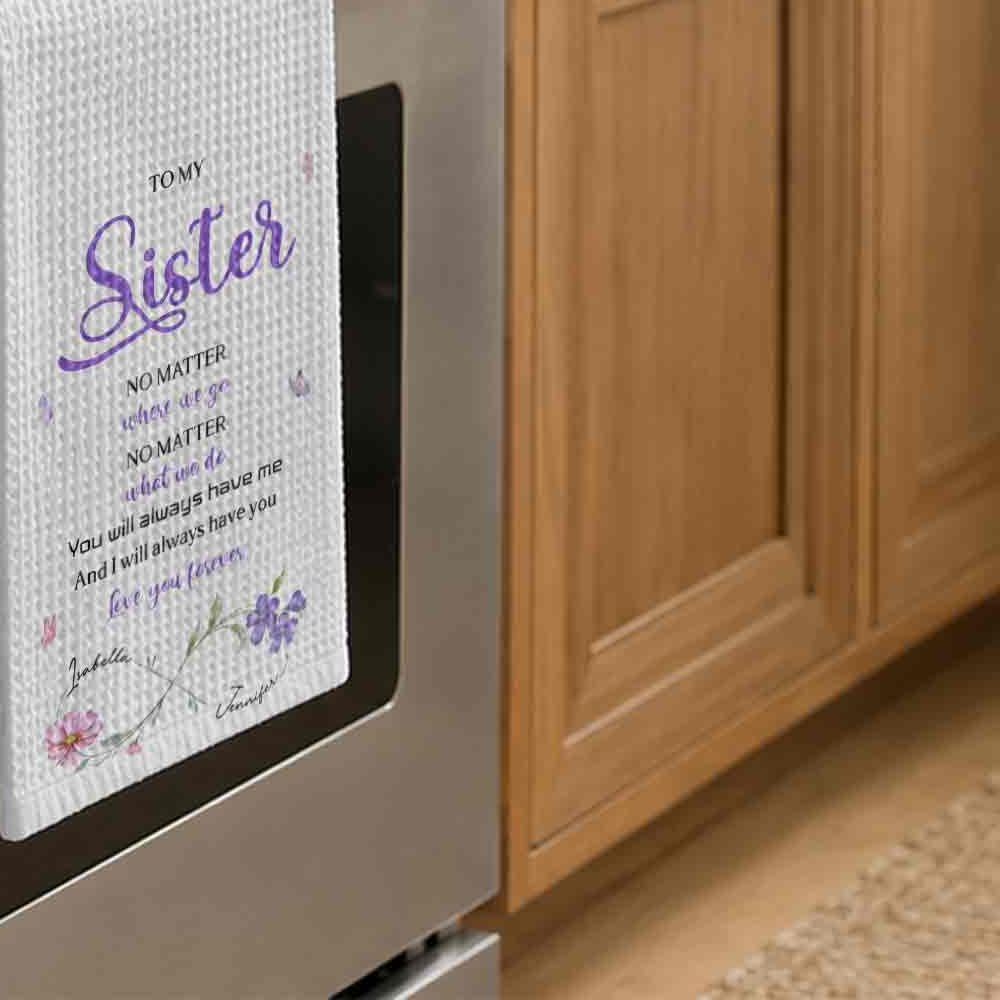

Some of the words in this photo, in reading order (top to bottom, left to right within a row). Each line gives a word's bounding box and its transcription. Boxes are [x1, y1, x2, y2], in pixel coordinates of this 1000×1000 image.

[149, 170, 175, 193] TO
[178, 159, 205, 183] MY
[57, 199, 297, 372] Sister
[127, 372, 153, 397] NO
[157, 344, 228, 386] MATTER
[121, 399, 171, 432] where
[178, 388, 202, 409] we
[207, 377, 230, 408] go
[127, 444, 153, 469] NO
[157, 415, 228, 457] MATTER
[122, 464, 171, 502] what
[175, 461, 201, 482] we
[204, 446, 228, 472] do
[68, 535, 103, 558] You
[108, 515, 135, 542] will
[139, 491, 203, 529] always
[208, 472, 254, 500] have
[258, 459, 284, 481] me
[73, 561, 108, 592] And
[111, 560, 118, 577] I
[119, 542, 149, 569] will
[152, 524, 206, 558] always
[209, 507, 247, 534] have
[248, 493, 278, 521] you
[148, 572, 183, 610] you
[66, 647, 133, 697] Isabella
[215, 675, 280, 720] Jennifer
